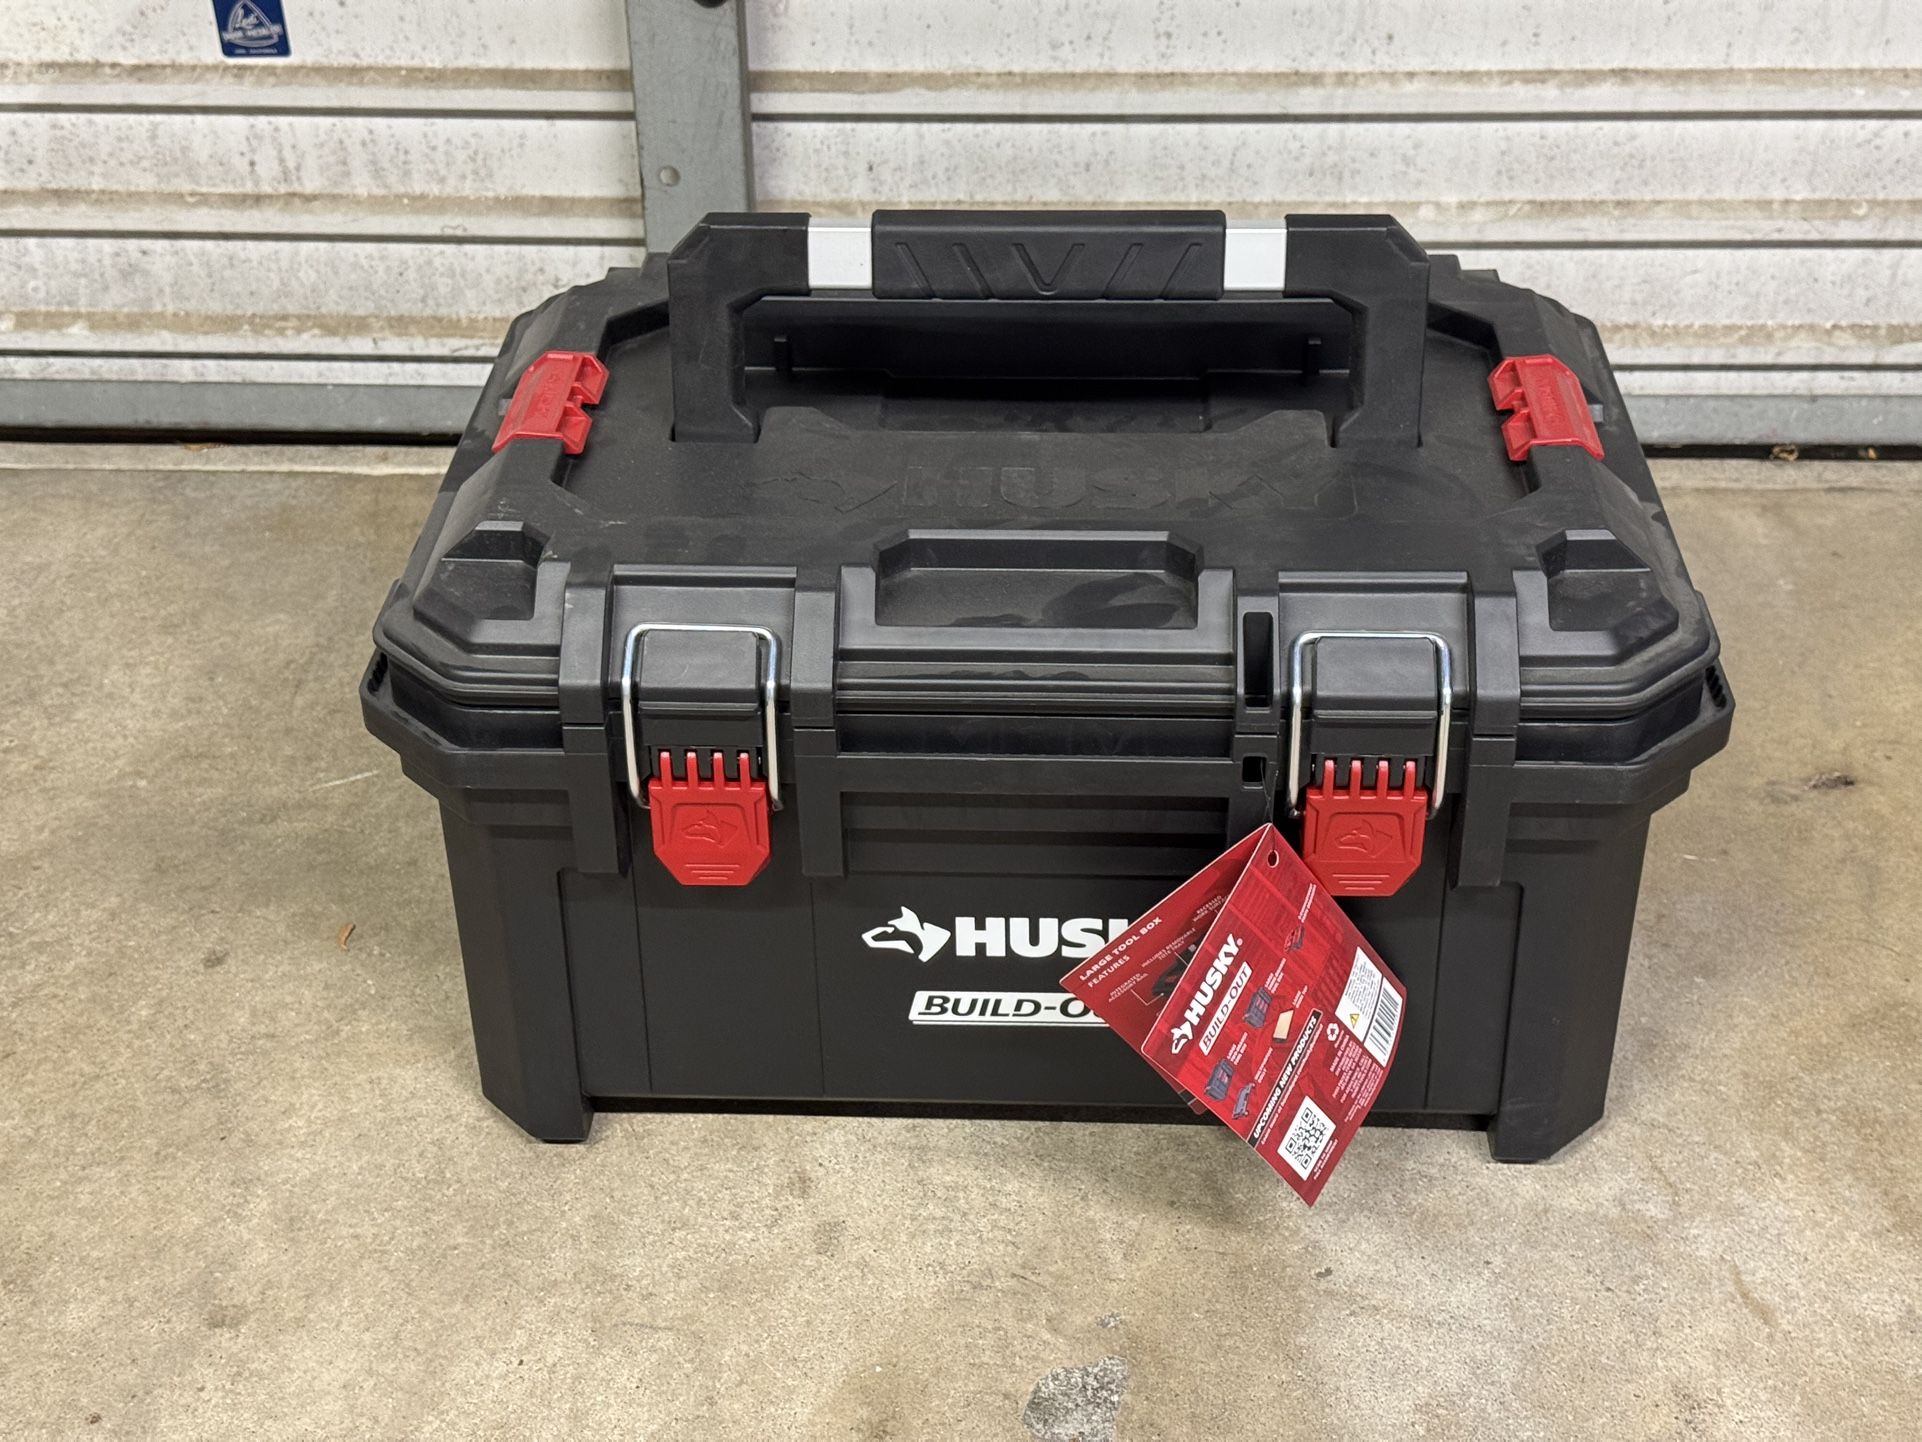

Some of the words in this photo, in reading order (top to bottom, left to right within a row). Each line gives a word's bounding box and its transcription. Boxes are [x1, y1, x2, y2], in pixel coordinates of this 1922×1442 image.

[955, 916, 1127, 958] HUS
[1079, 953, 1113, 981] LARGE
[1111, 932, 1140, 956] TOOL
[1139, 916, 1162, 935] BOX
[1087, 953, 1130, 988] FEATURES
[1183, 933, 1240, 1026] HUSKY
[918, 995, 1104, 1018] BUILD-O
[1202, 965, 1248, 1049] BUILD-OUT
[1252, 1087, 1282, 1138] UPCOMING
[1278, 1062, 1294, 1088] NEW
[1288, 1015, 1317, 1065] PRODUCTS
